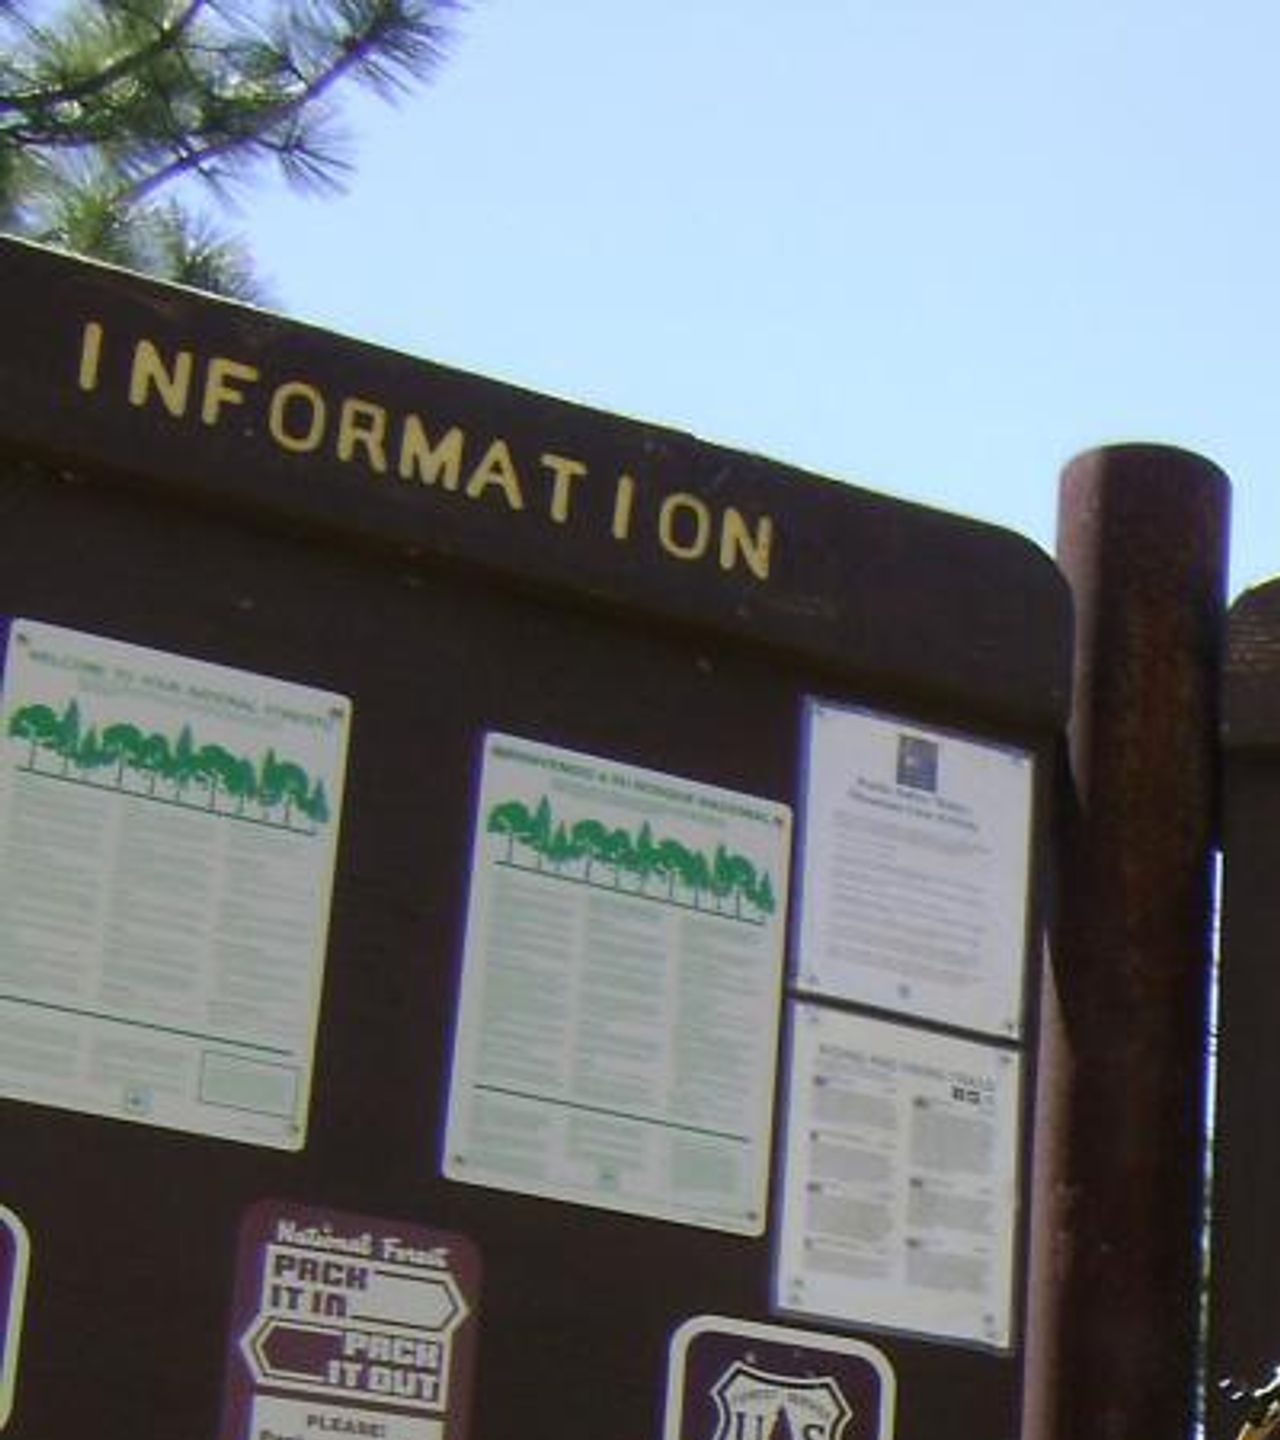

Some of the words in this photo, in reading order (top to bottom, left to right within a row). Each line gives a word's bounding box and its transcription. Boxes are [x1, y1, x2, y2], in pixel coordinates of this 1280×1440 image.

[76, 320, 775, 580] INFORMATION
[276, 1219, 373, 1256] National
[272, 1254, 370, 1291] PACK
[271, 1284, 304, 1311] IT
[347, 1331, 442, 1368] PACK
[328, 1359, 364, 1387] IT
[368, 1368, 440, 1401] OUT
